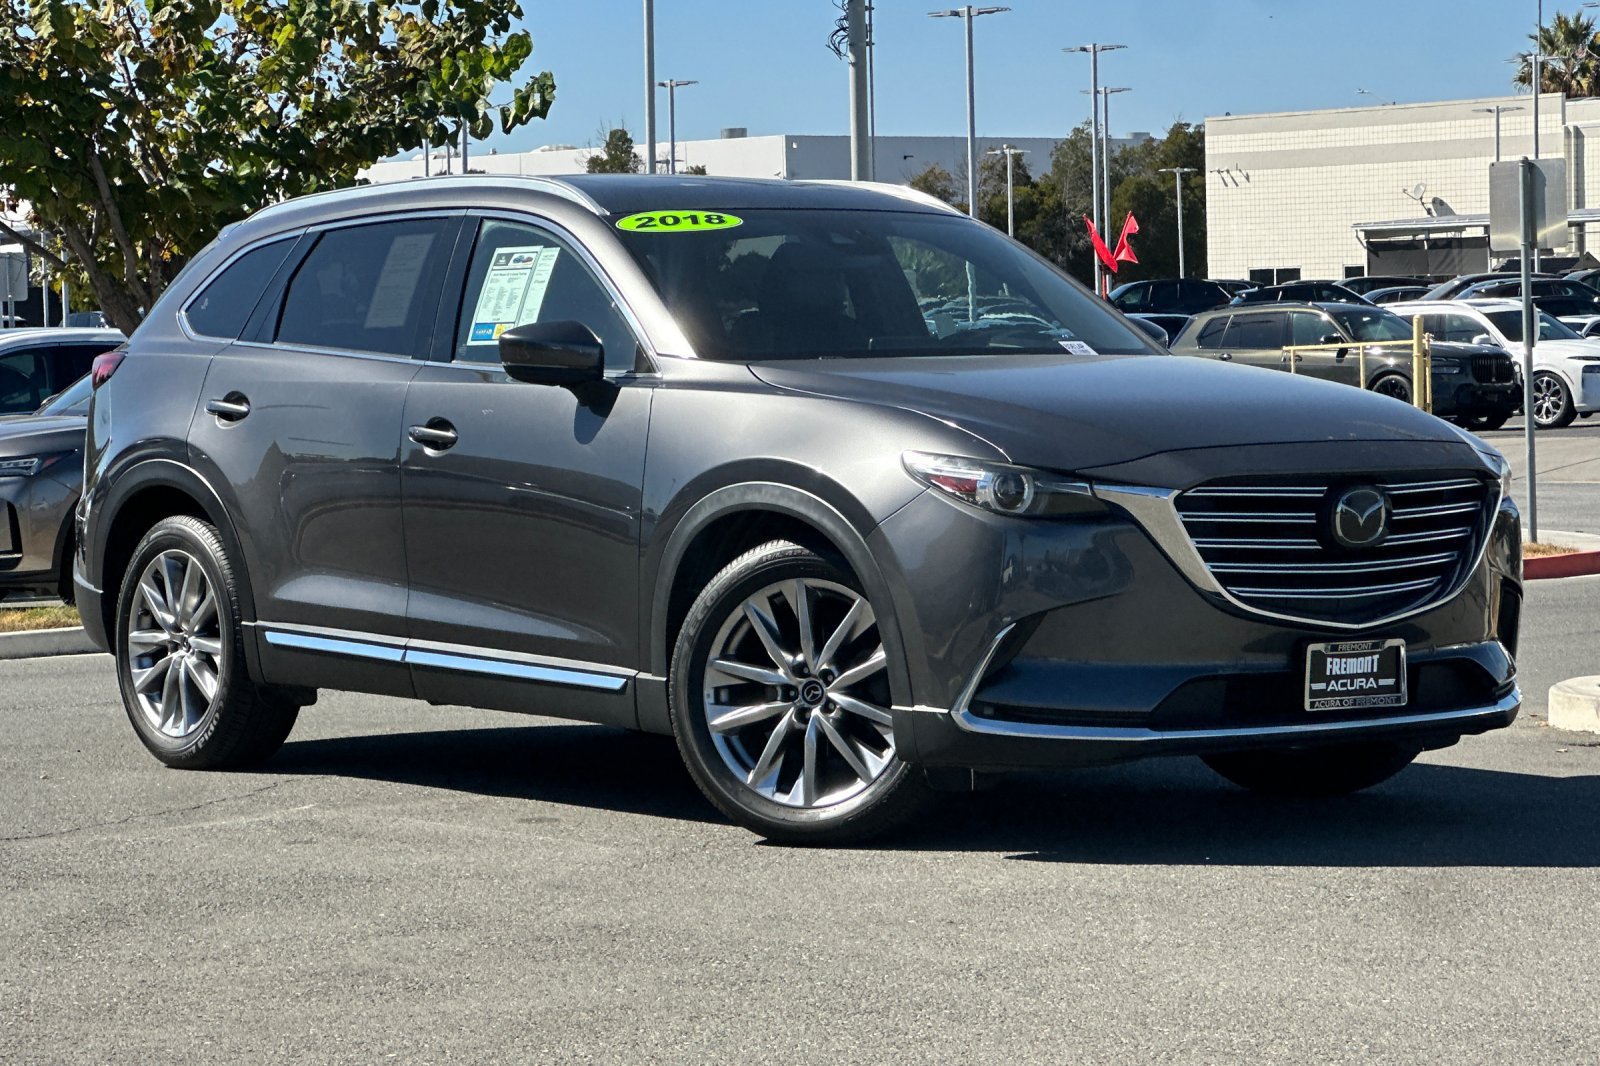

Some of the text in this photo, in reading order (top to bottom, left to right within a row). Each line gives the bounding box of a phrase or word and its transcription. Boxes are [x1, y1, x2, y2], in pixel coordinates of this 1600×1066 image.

[635, 214, 726, 229] 2018
[1338, 643, 1372, 652] FREMONT
[1326, 654, 1379, 675] FREMONT
[1327, 677, 1376, 691] ACURA
[1314, 700, 1341, 708] ACURA
[1356, 697, 1396, 706] FREMONT
